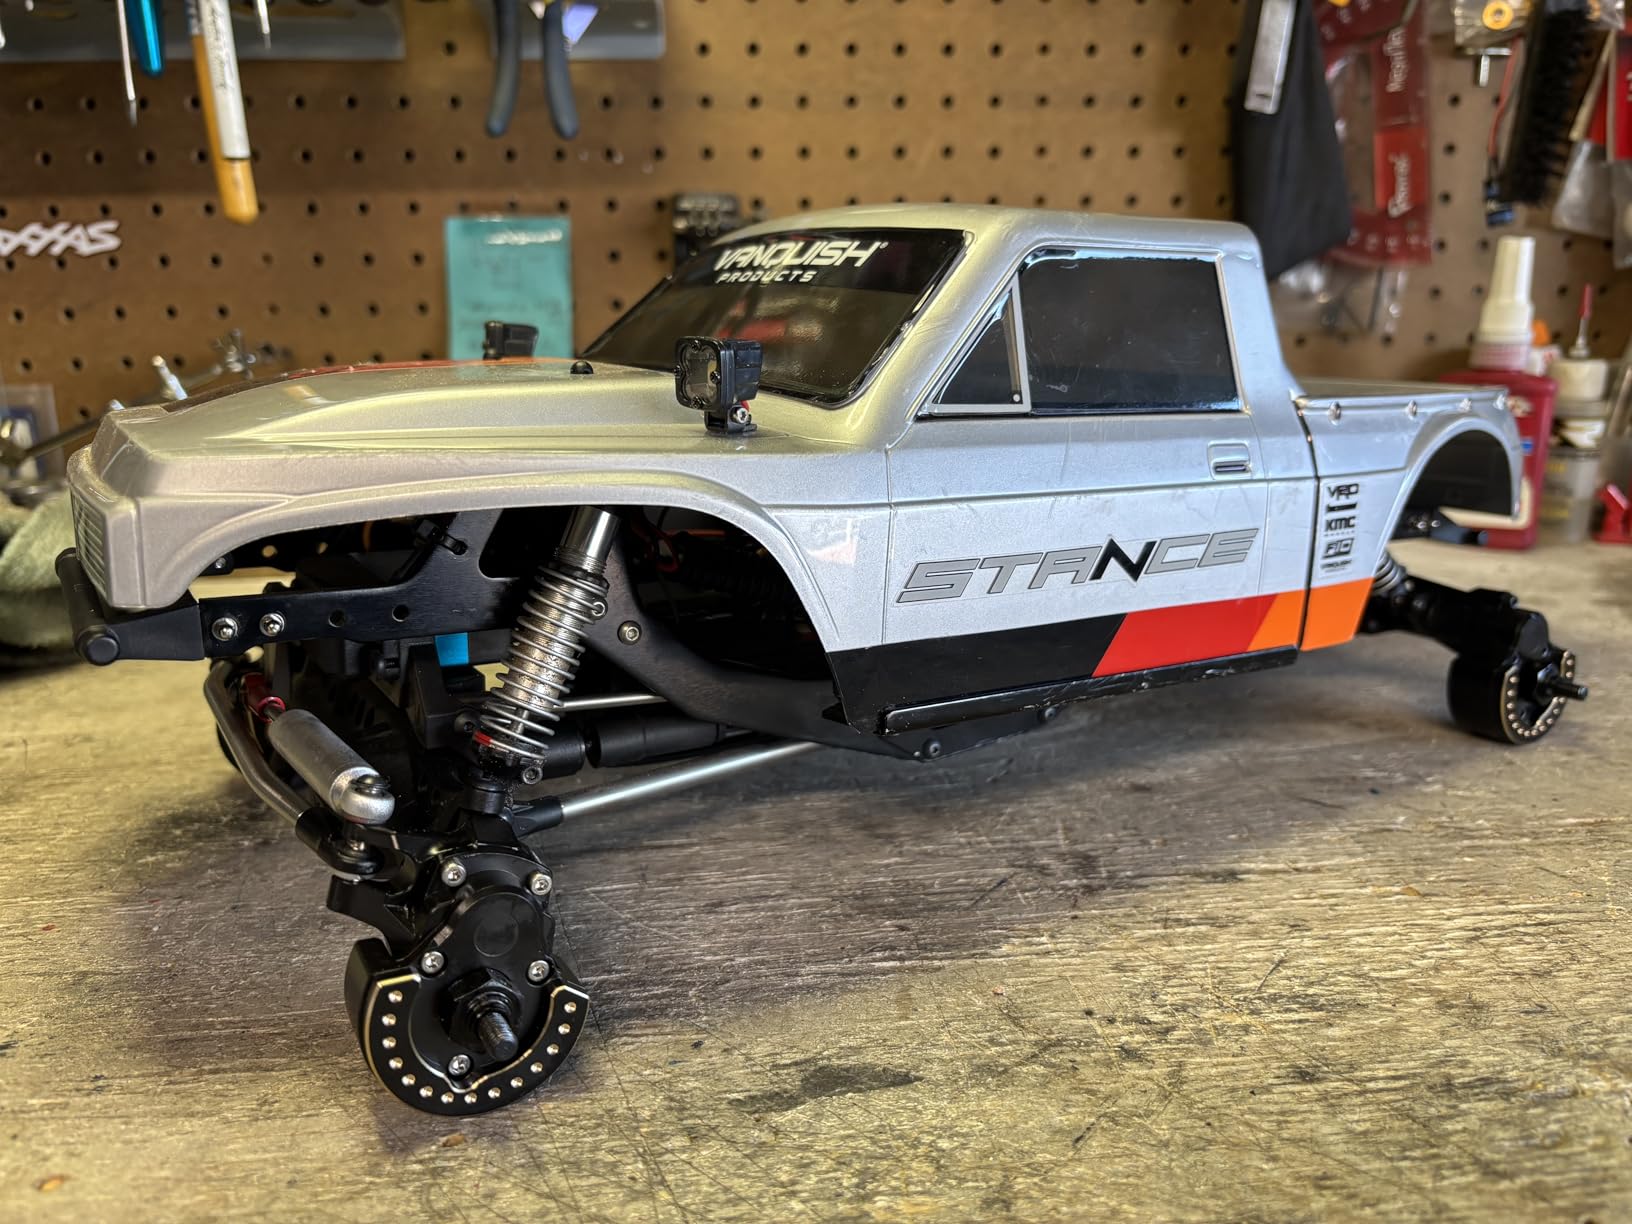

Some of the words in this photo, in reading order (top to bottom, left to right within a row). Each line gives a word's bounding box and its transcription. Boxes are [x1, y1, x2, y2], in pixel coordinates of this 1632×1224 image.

[714, 240, 881, 271] VANQUISH
[717, 270, 817, 284] PRODUCTS
[1325, 515, 1356, 532] KMC
[896, 528, 1259, 604] STANCE
